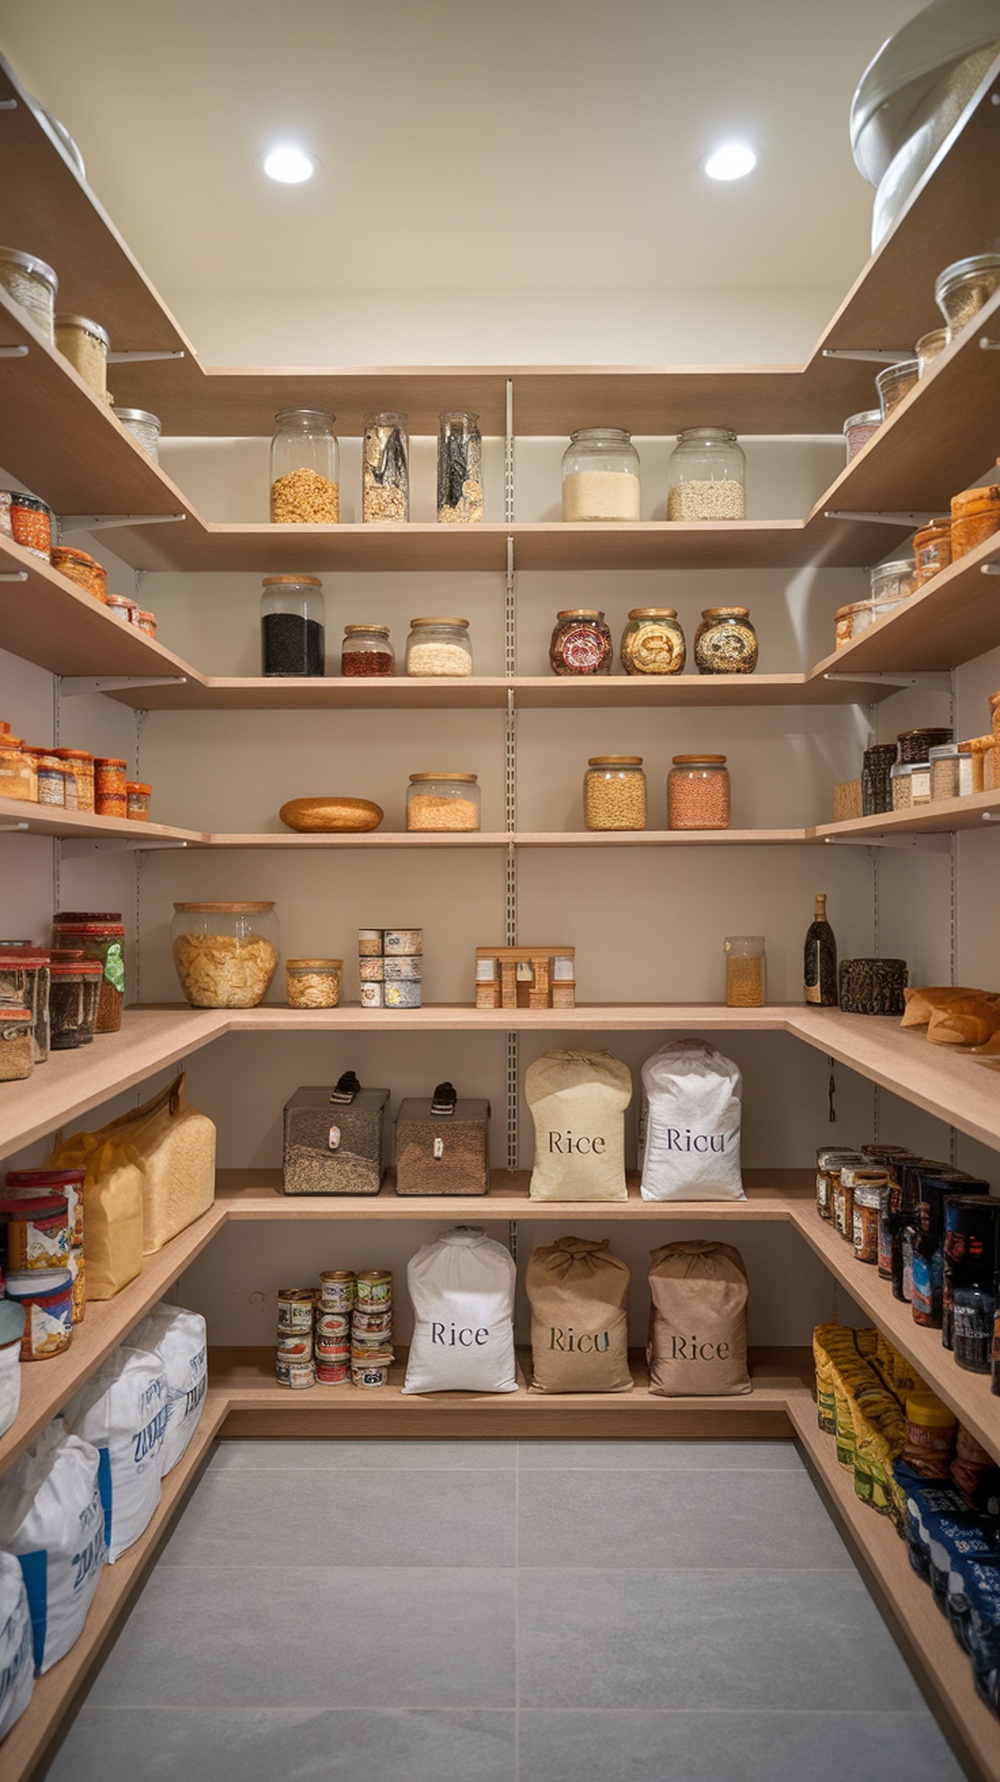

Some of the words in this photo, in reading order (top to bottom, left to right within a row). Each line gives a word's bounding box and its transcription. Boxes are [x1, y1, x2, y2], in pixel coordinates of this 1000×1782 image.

[548, 1130, 606, 1154] Rice
[667, 1128, 726, 1153] Ricu
[431, 1322, 490, 1347] Rice
[671, 1335, 729, 1361] Rice
